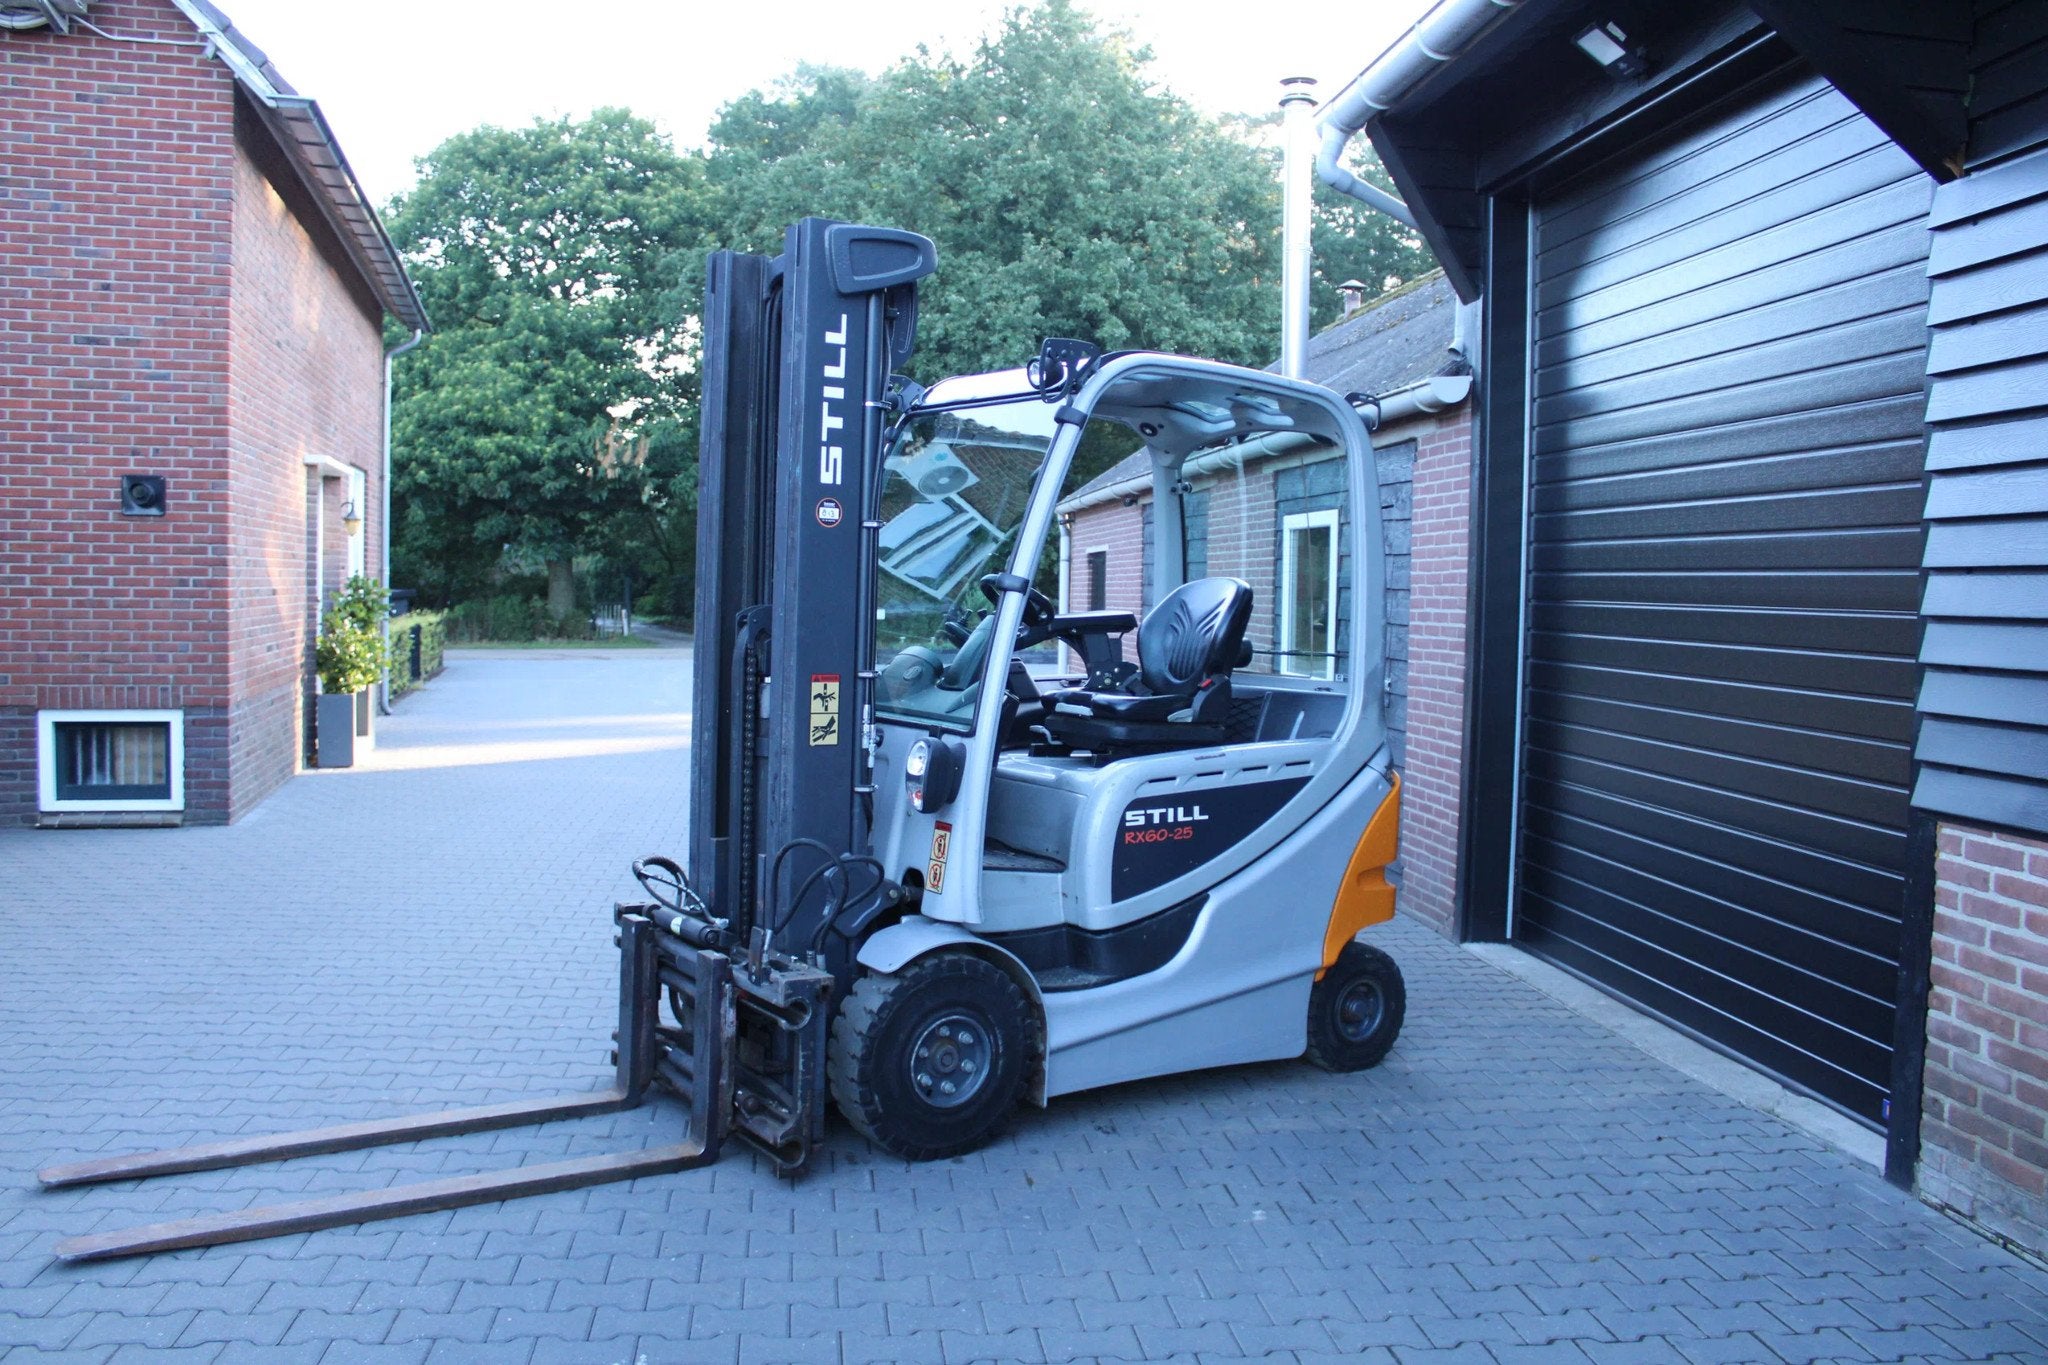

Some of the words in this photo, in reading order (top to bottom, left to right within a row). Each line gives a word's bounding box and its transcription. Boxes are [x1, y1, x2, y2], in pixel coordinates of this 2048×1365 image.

[820, 313, 848, 485] STILL
[1125, 805, 1209, 827] STILL
[1124, 826, 1194, 844] RX60-25
